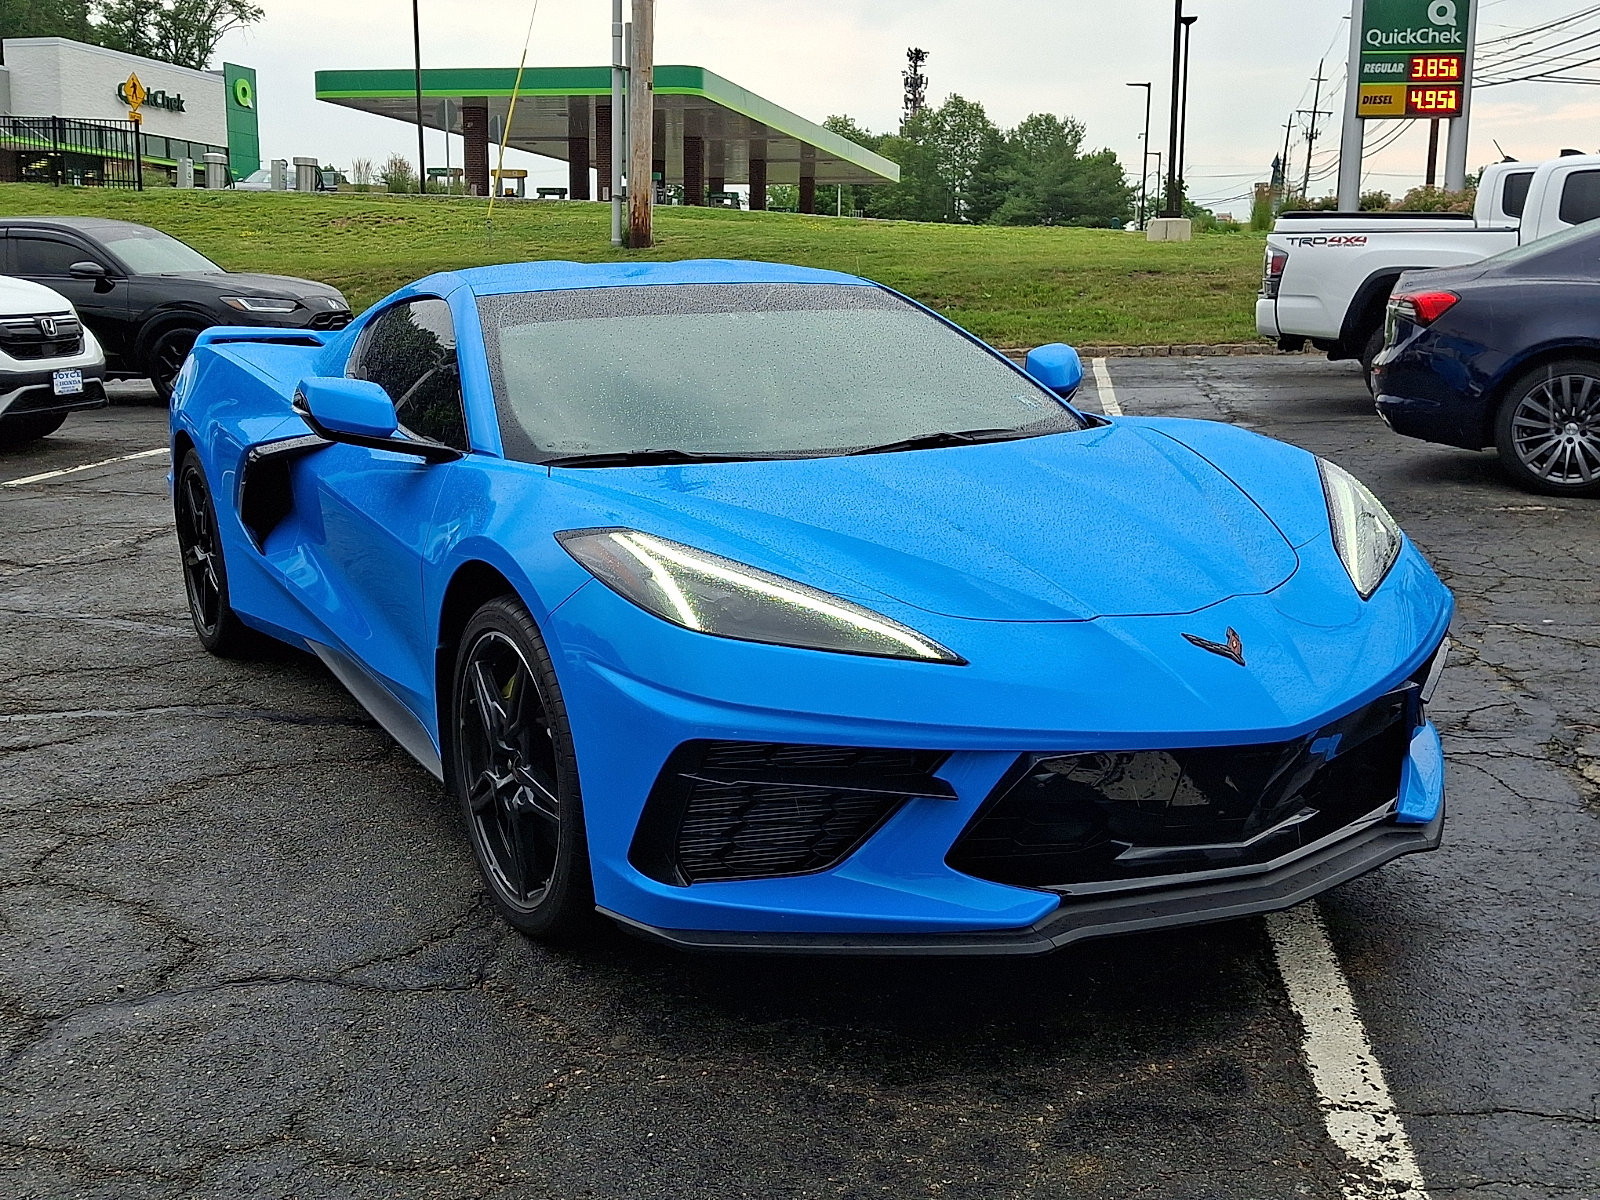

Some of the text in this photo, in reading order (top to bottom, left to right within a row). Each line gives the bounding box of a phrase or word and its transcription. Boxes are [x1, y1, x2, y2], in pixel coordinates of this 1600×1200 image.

[1427, 0, 1457, 26] Q
[1366, 27, 1462, 47] QuickChek
[1363, 62, 1405, 74] REGULAR
[1362, 95, 1393, 105] DIESEL
[1286, 236, 1328, 248] TRD
[53, 371, 82, 380] JOYCE
